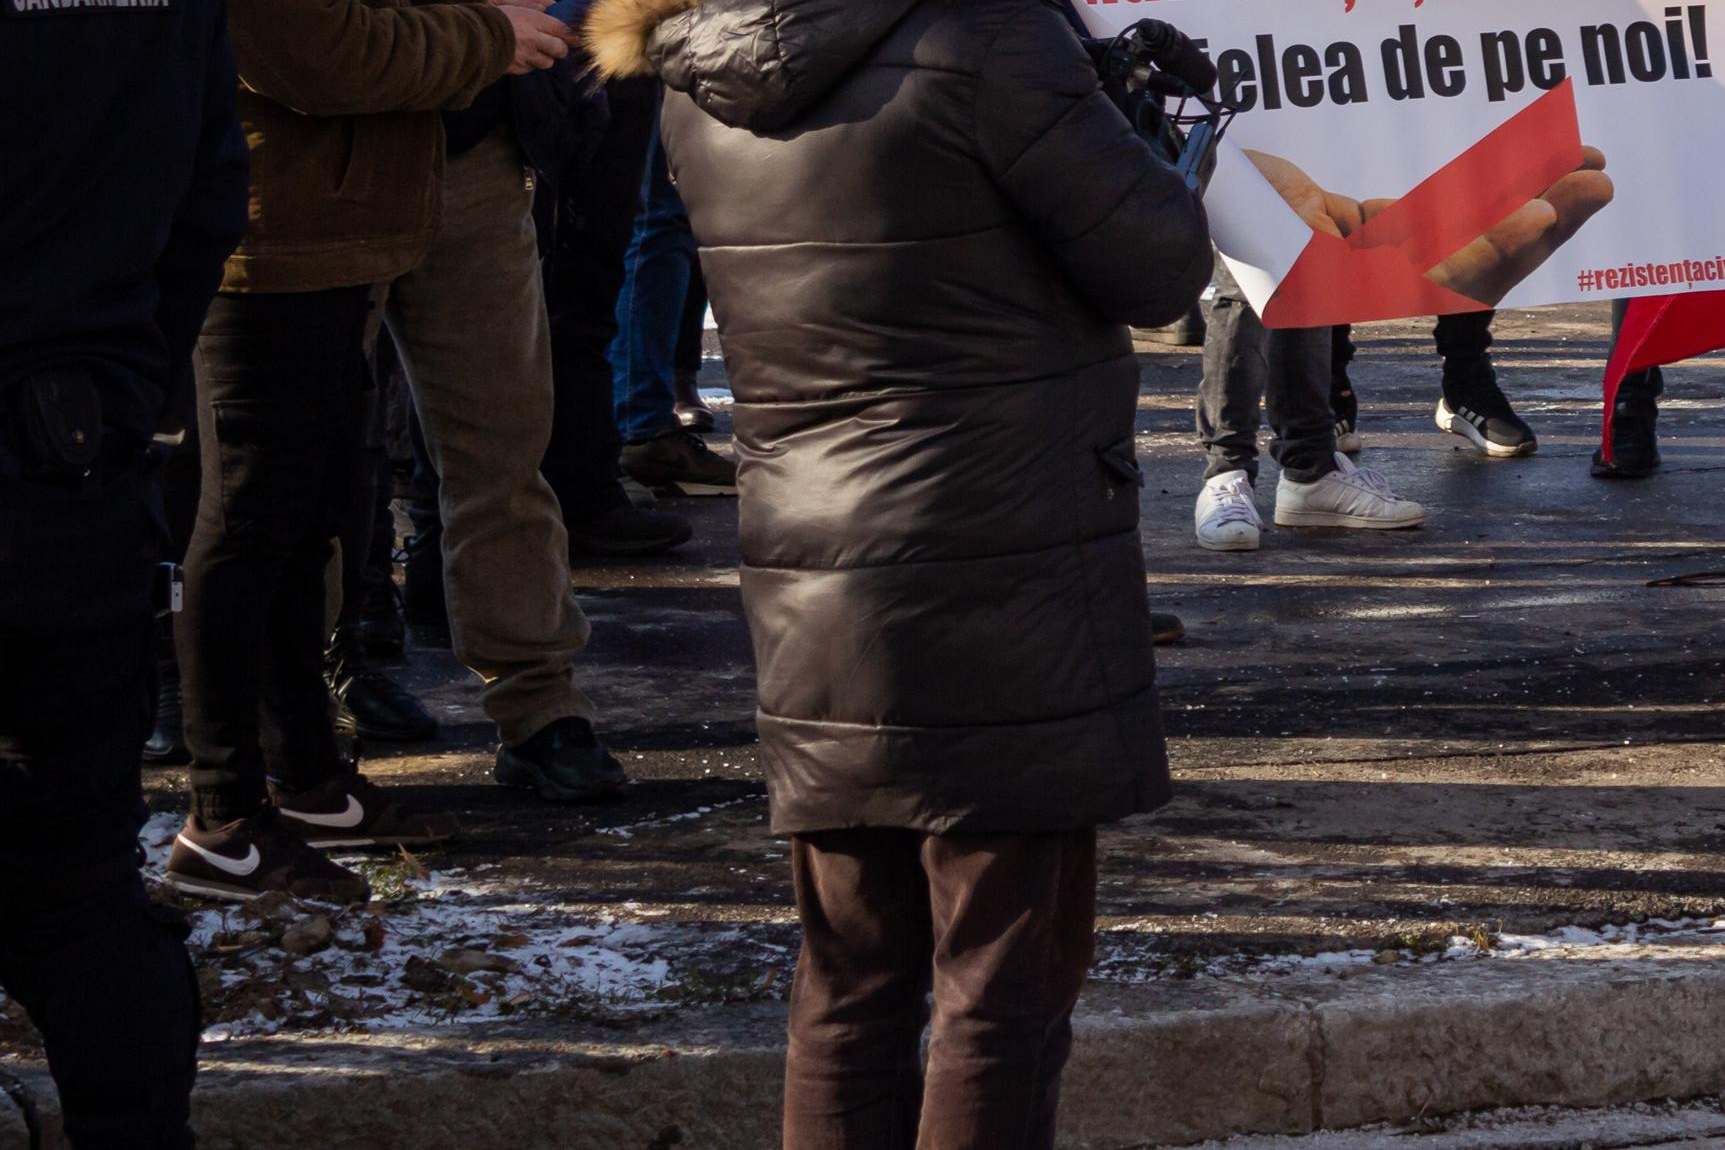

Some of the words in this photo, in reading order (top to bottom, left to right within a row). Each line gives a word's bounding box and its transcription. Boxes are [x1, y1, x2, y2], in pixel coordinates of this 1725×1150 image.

[1381, 24, 1466, 101] de
[1480, 27, 1567, 102] pe
[1580, 5, 1712, 86] noi!
